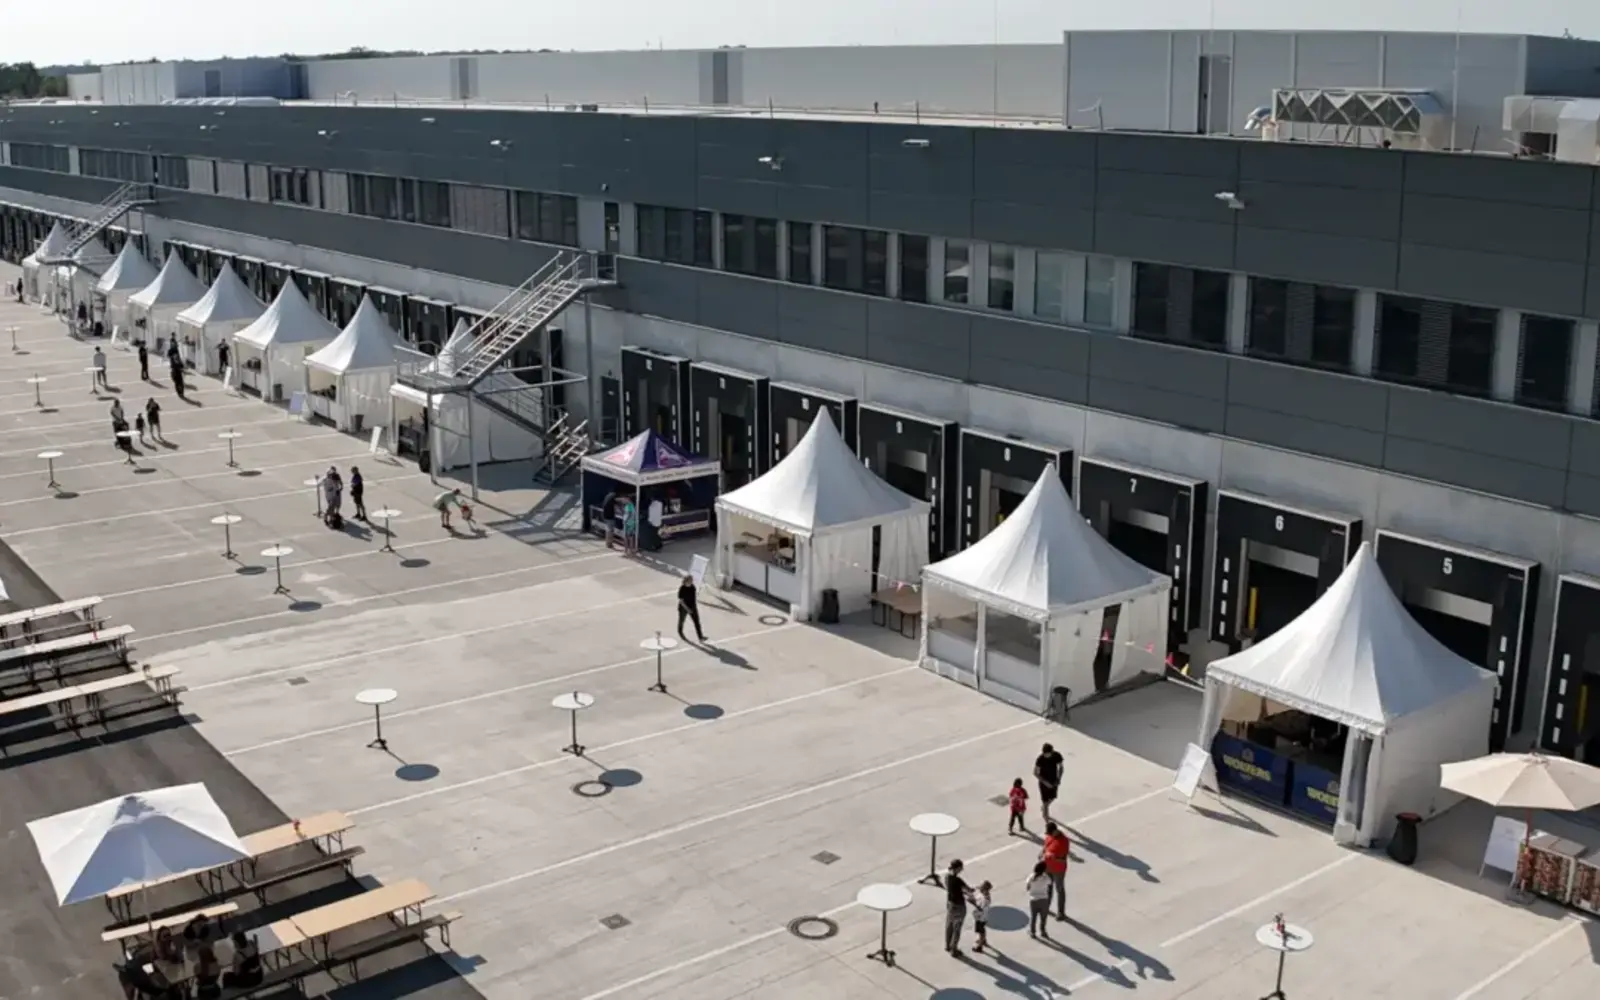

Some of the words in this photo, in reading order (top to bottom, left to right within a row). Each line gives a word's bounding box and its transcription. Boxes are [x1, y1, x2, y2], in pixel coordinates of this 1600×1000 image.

[1130, 478, 1137, 493] 7
[1275, 515, 1284, 531] 6
[1443, 558, 1452, 574] 5
